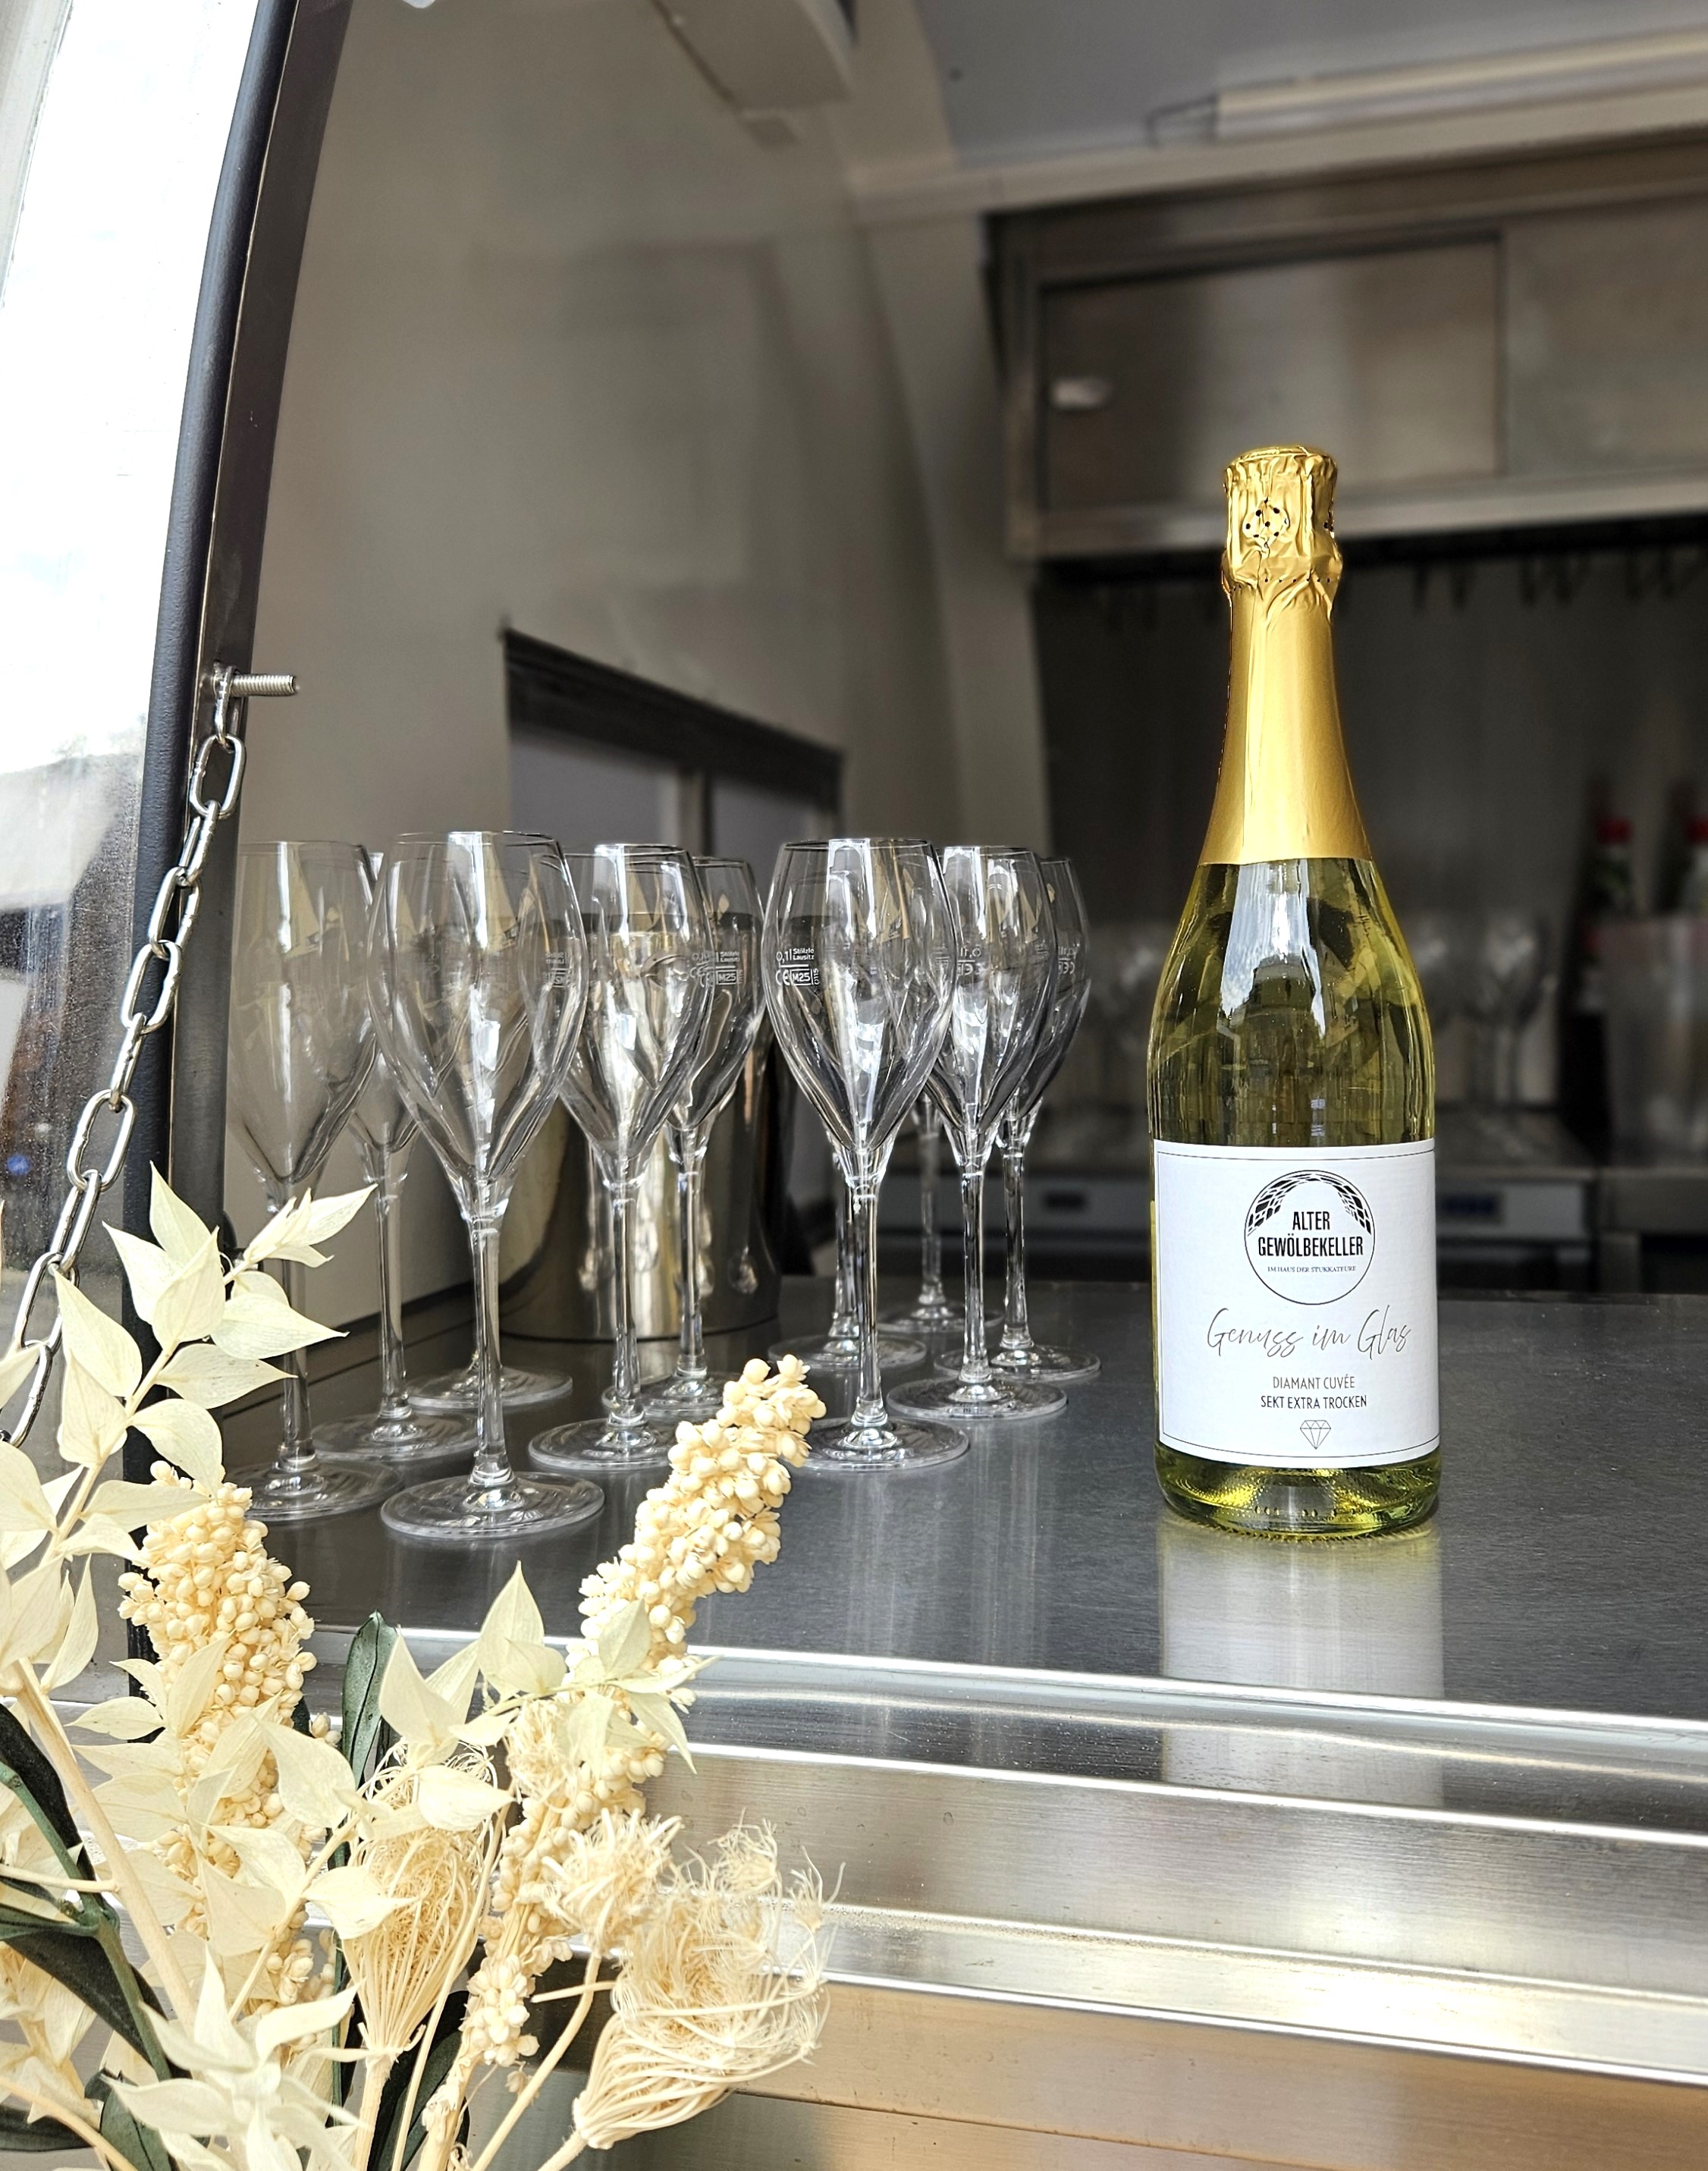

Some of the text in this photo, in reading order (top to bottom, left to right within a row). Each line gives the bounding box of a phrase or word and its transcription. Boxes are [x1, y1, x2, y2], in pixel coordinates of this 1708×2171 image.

[718, 972, 736, 982] M25
[792, 972, 811, 982] M25
[1292, 1211, 1330, 1230] ALTER
[1258, 1233, 1364, 1257] GEWÖLBEKELLER
[1207, 1305, 1411, 1360] Genuss im Glas
[1273, 1374, 1355, 1390] DIAMANT CUVÉE
[1261, 1394, 1367, 1409] SEKT EXTRA TROCKEN
